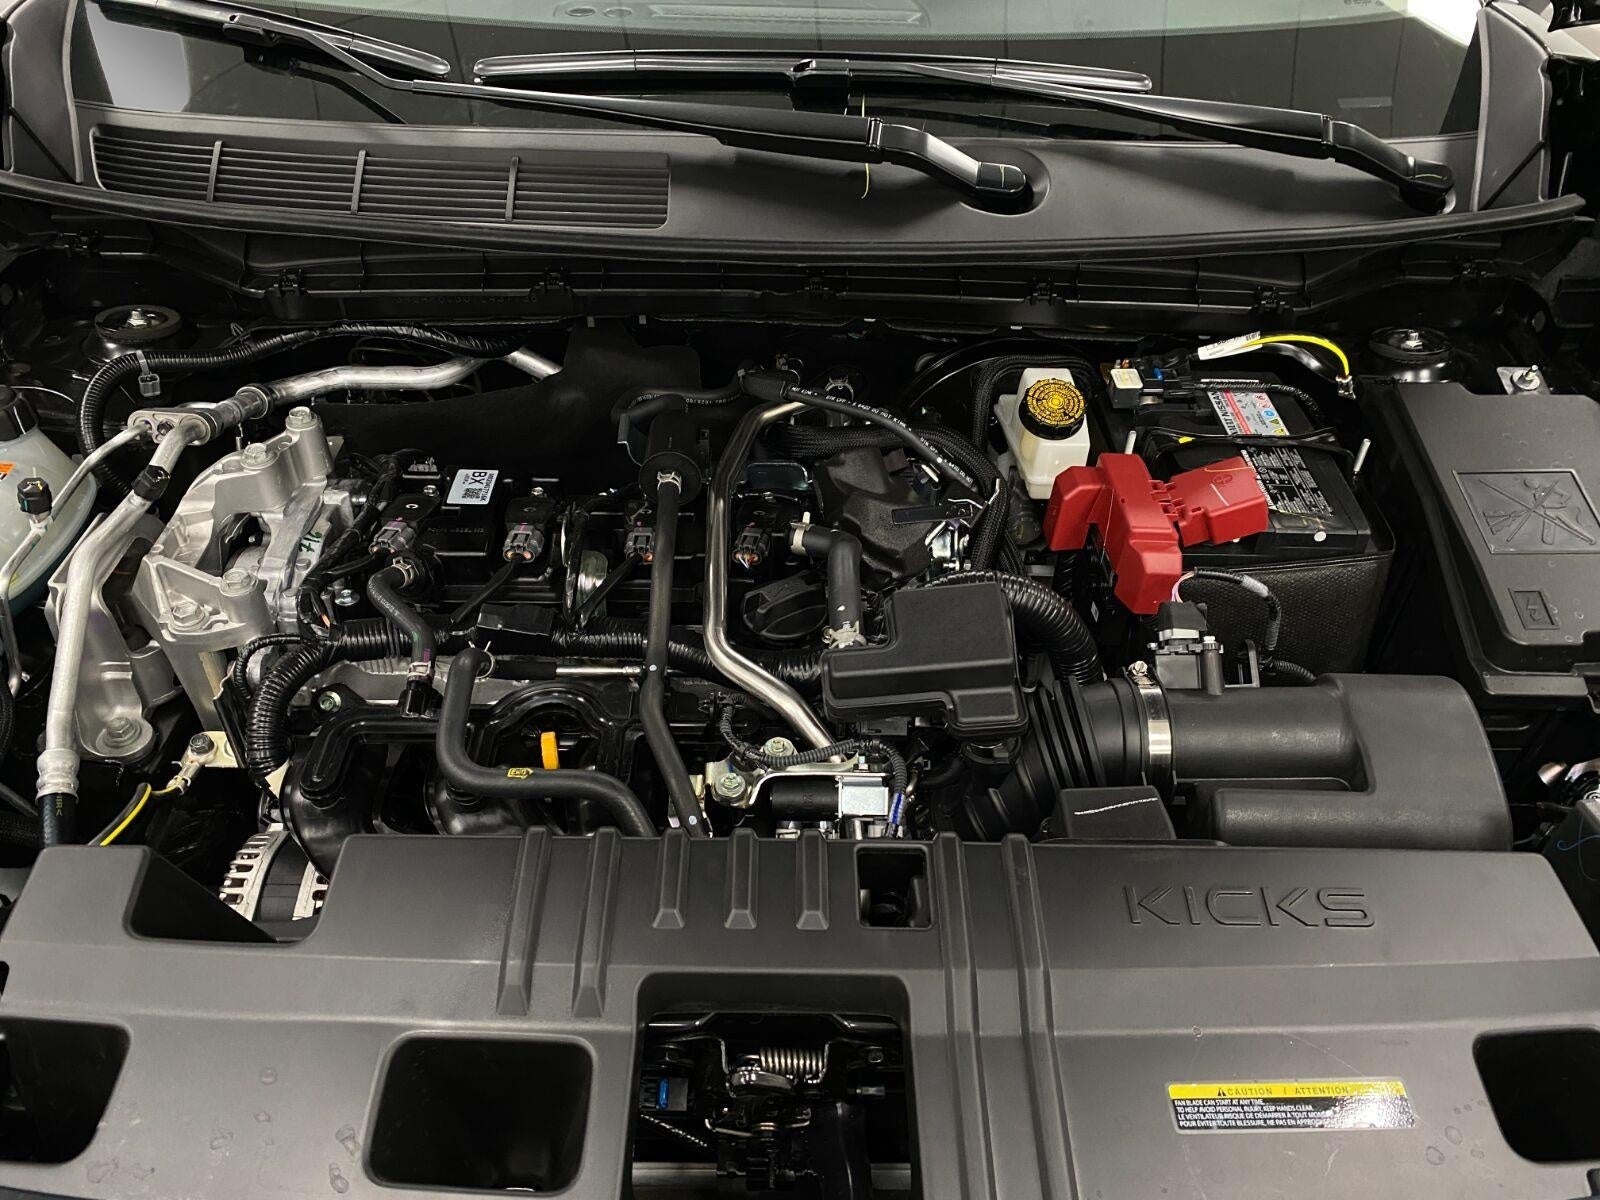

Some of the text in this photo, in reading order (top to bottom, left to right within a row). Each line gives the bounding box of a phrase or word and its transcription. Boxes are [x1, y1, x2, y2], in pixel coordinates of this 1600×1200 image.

[468, 471, 488, 485] BX
[1123, 886, 1375, 928] KICKS
[1227, 1086, 1349, 1096] CAUTION ATTENTION
